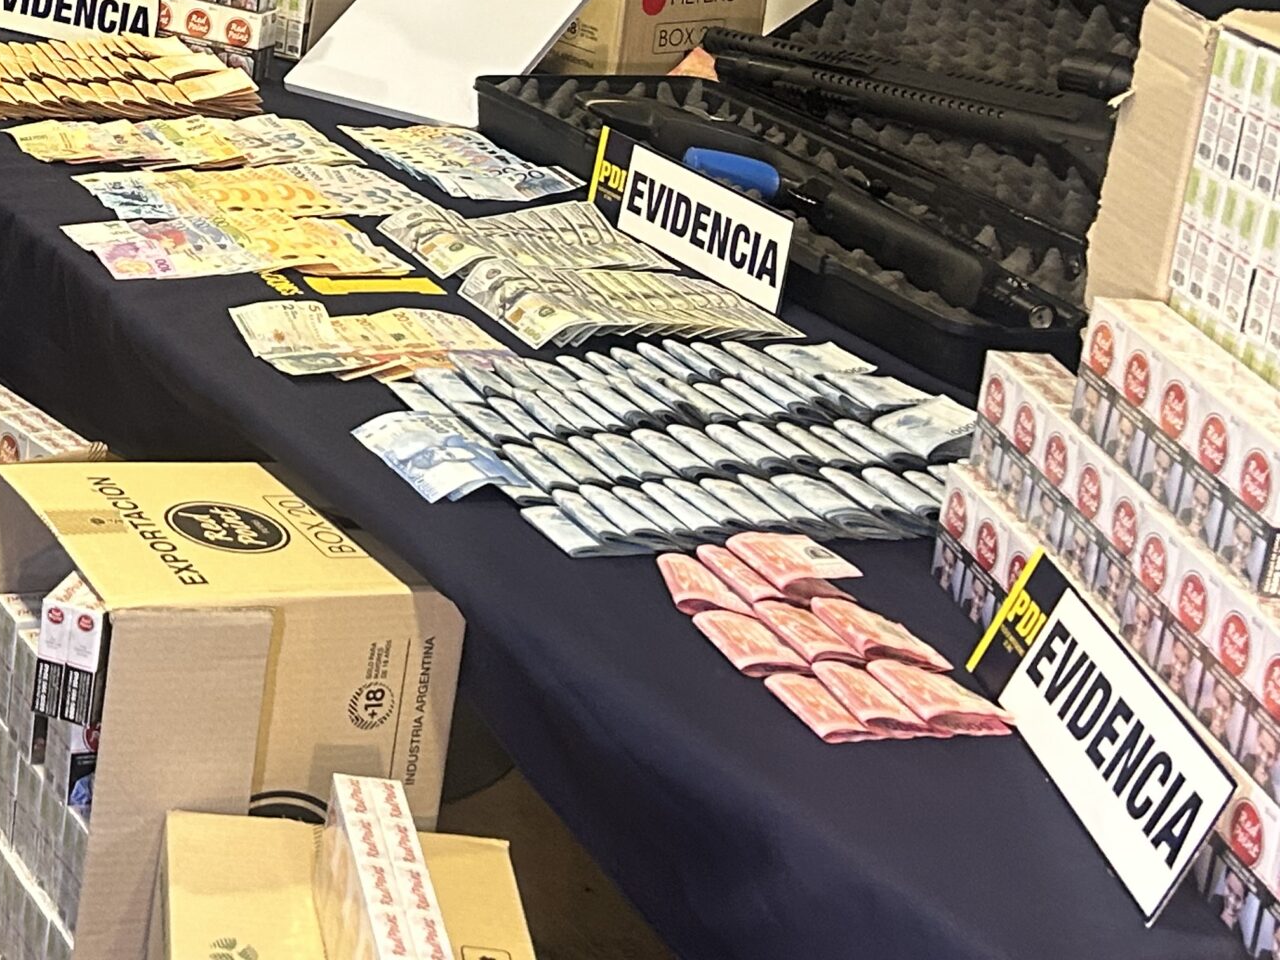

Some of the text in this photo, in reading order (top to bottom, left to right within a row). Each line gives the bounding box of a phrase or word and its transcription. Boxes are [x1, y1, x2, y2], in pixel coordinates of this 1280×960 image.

[658, 27, 694, 48] BOX
[599, 160, 778, 288] PDI EVIDENCIA
[87, 476, 209, 585] EXPORTACIÓN
[365, 688, 385, 719] +18
[406, 637, 435, 786] INDUSTRIA ARGENTINA
[1006, 589, 1203, 870] PDI EVIDENCIA
